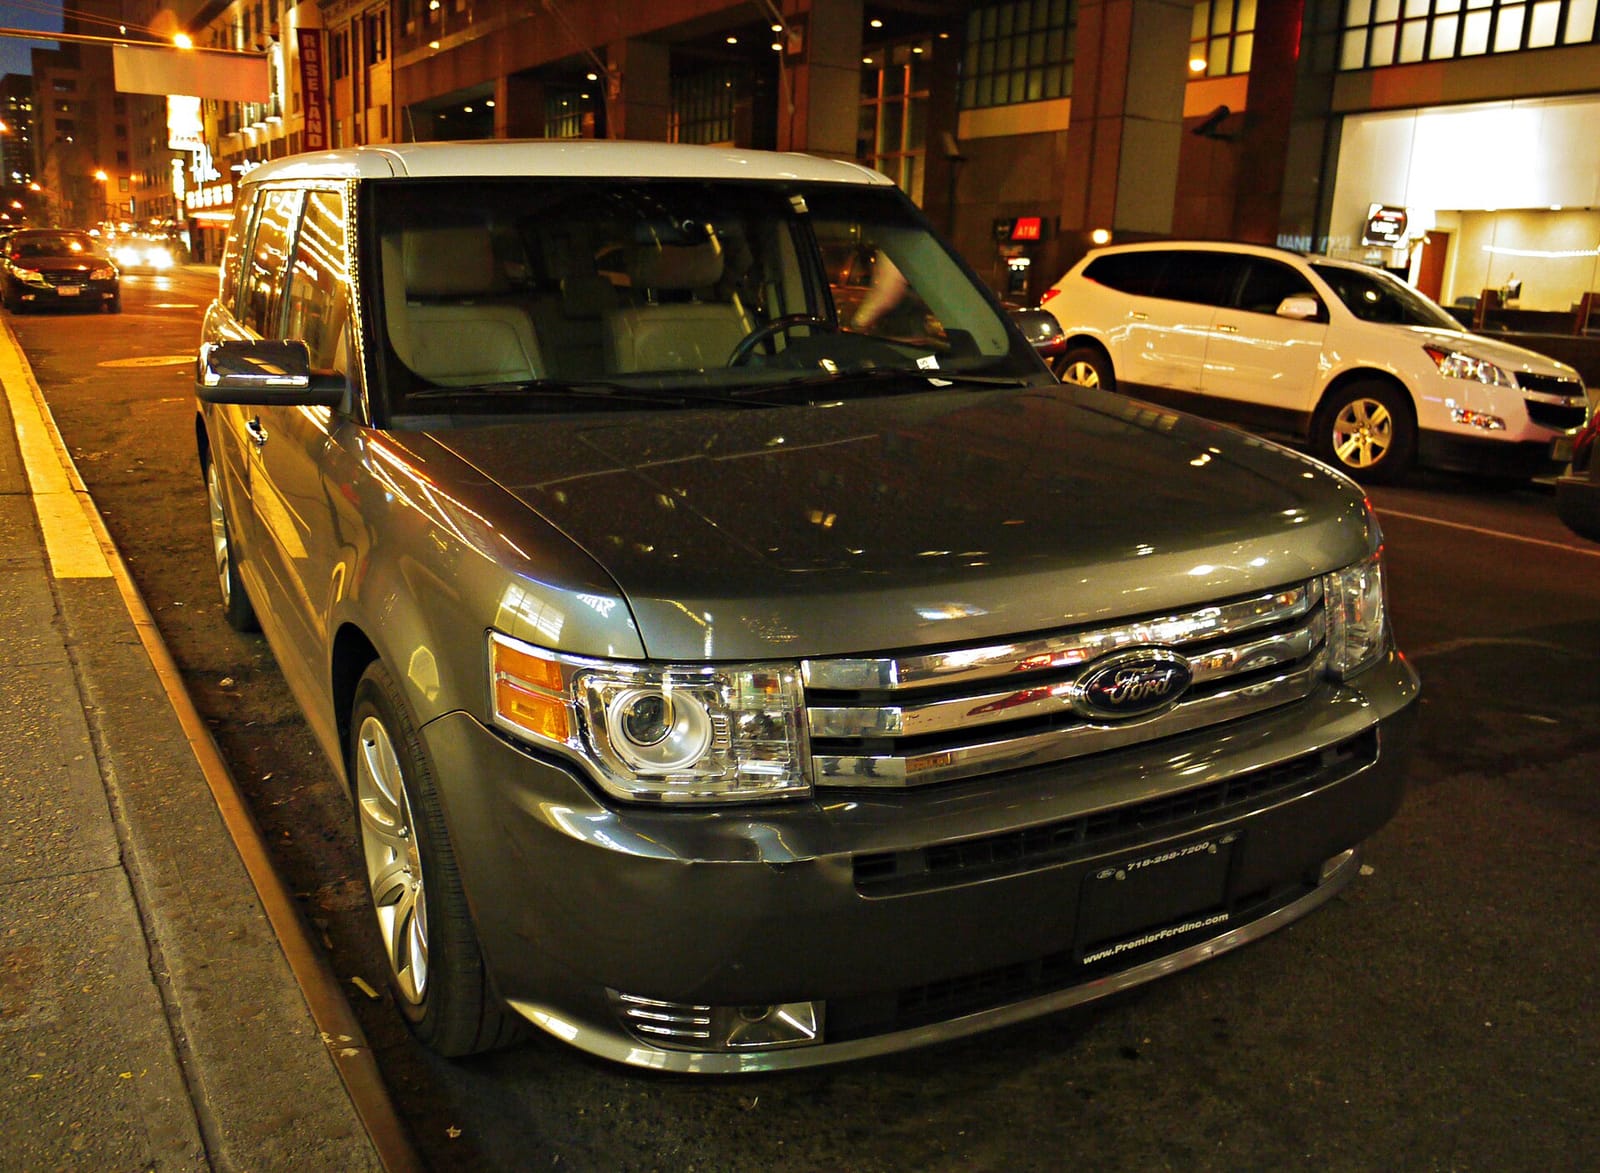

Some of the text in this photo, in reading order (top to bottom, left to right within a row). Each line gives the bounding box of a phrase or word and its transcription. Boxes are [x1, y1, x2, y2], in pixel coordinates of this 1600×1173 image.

[302, 34, 322, 147] ROSELAND
[1016, 226, 1037, 236] ATM
[1103, 663, 1175, 704] Ford
